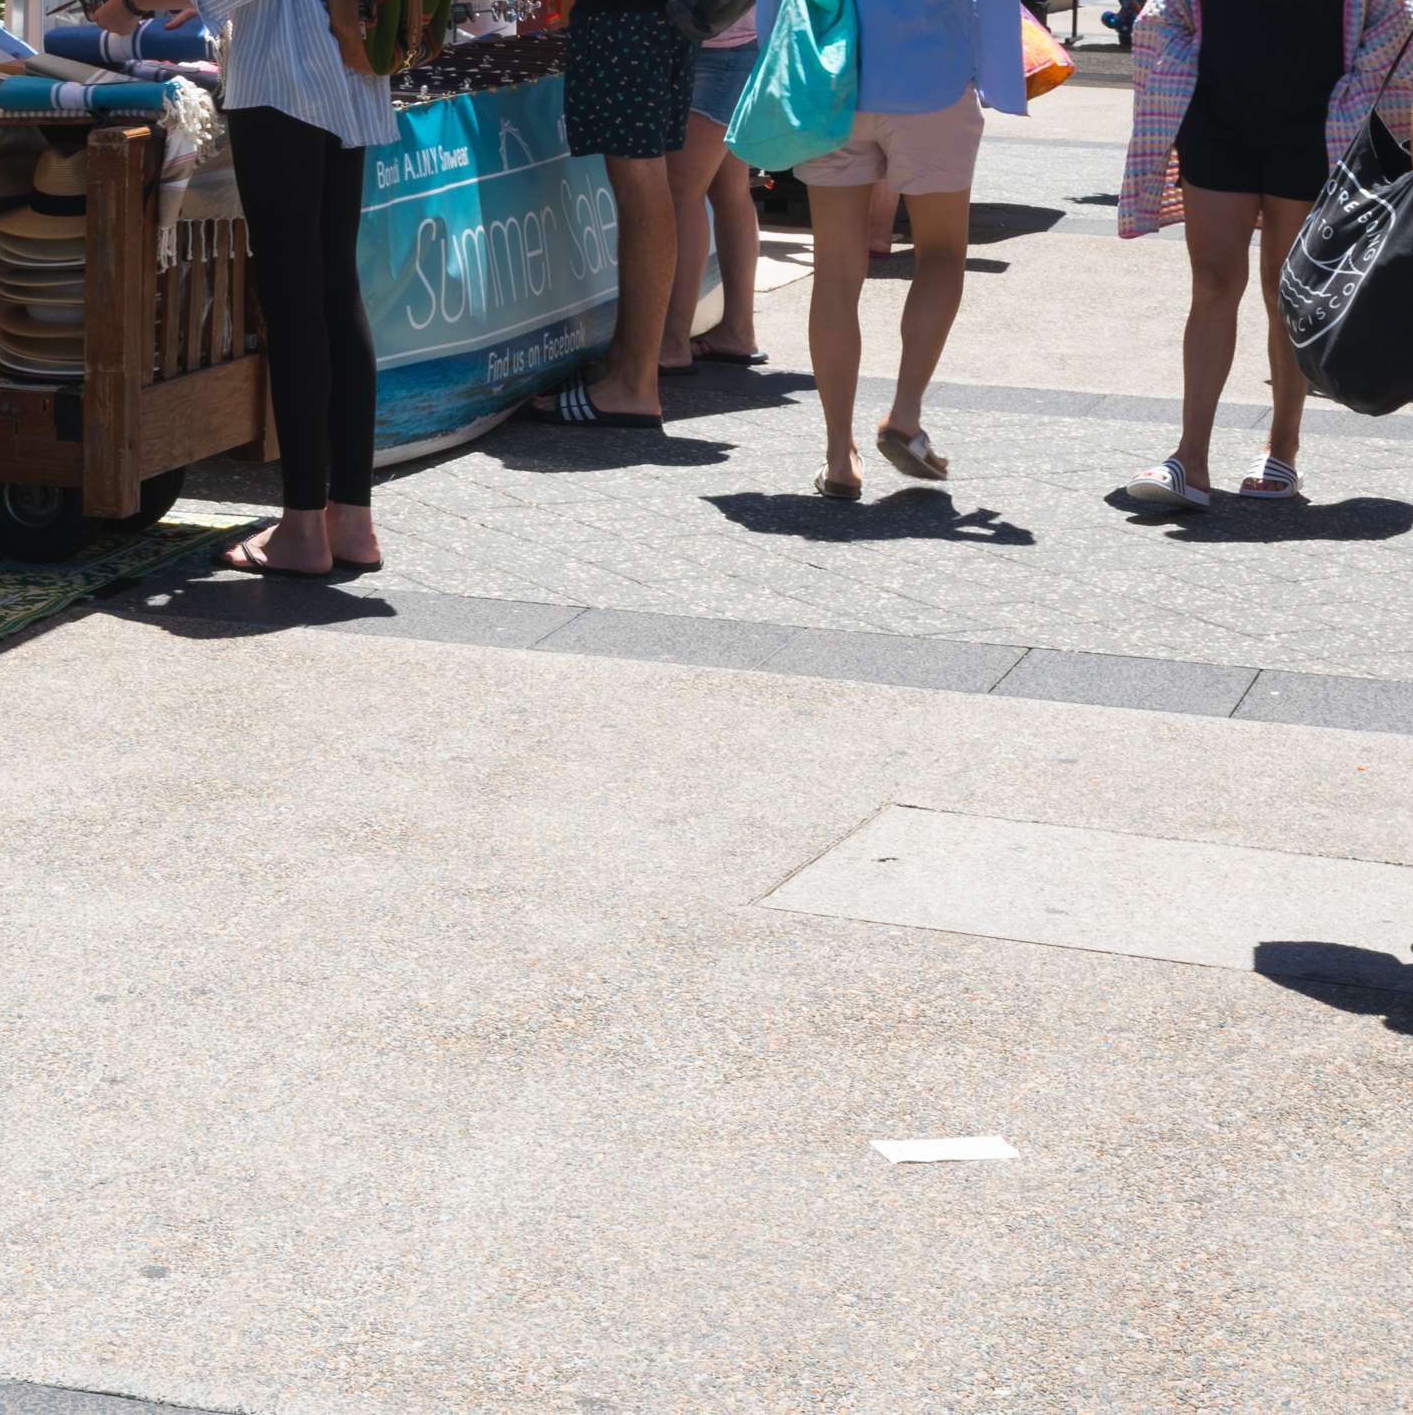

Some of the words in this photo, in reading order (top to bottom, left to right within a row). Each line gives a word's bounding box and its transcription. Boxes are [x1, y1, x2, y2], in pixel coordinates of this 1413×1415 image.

[406, 205, 557, 330] Summer
[560, 173, 619, 281] Sale
[1317, 218, 1334, 240] TO
[487, 347, 510, 384] Find
[513, 350, 525, 374] us
[528, 345, 540, 368] on
[543, 322, 586, 363] Facebook
